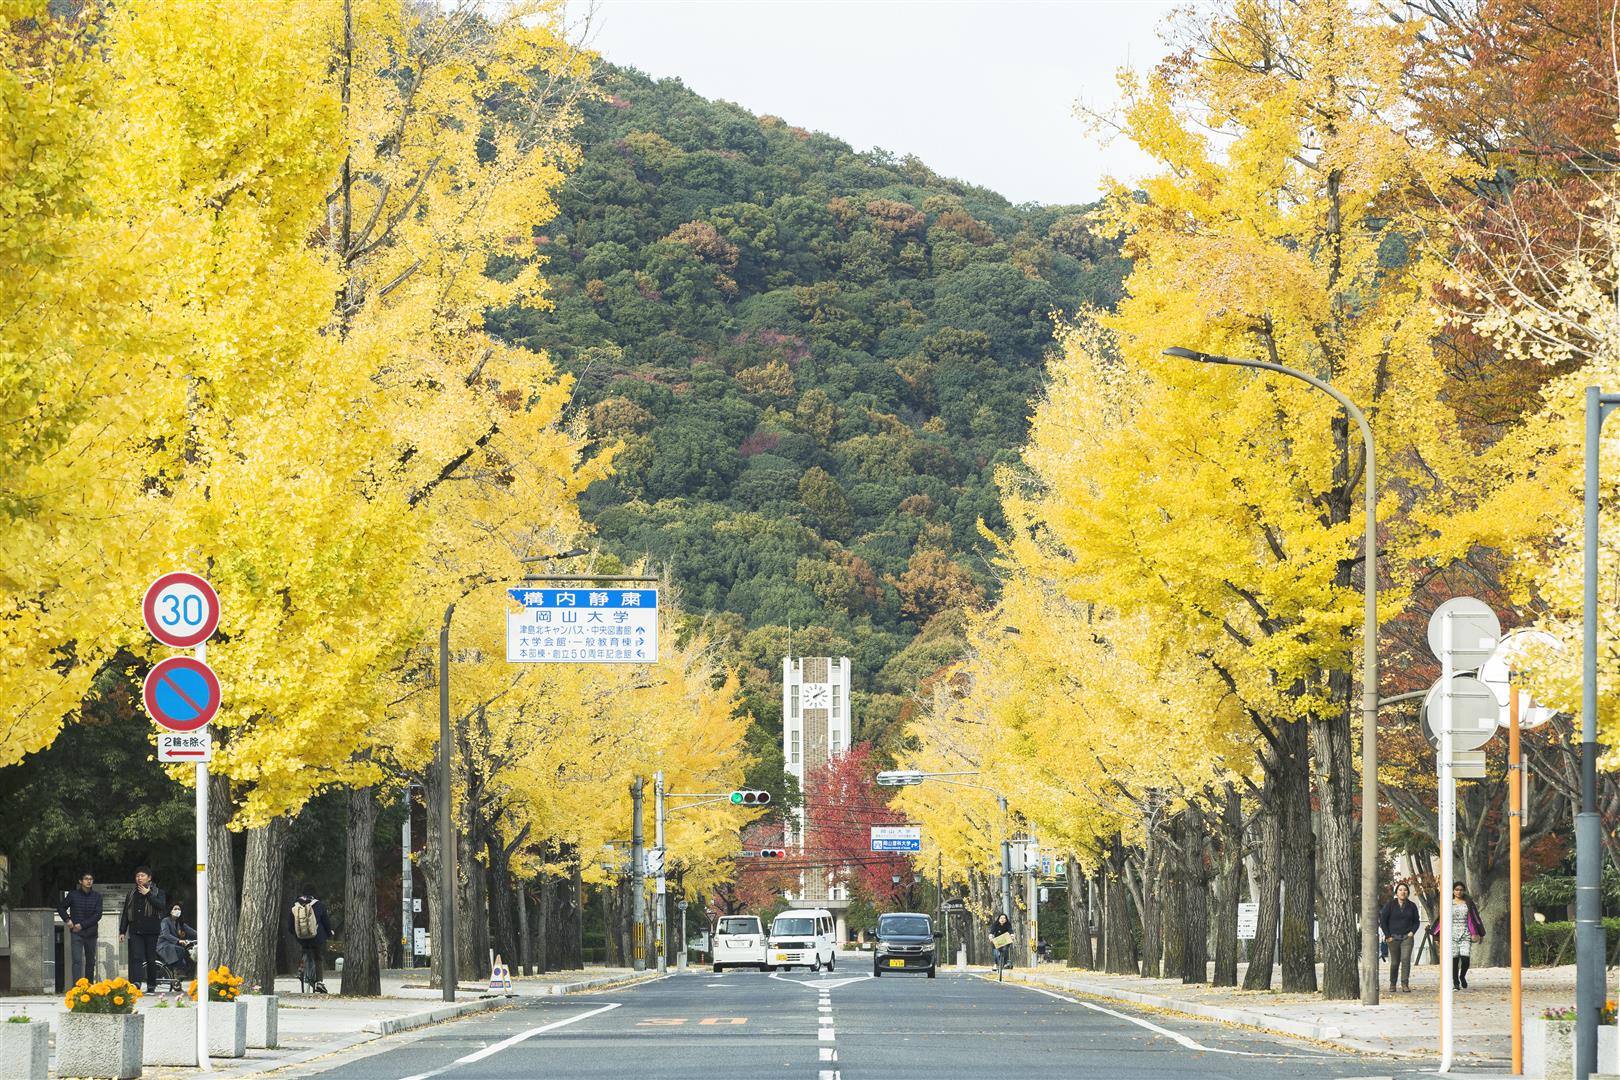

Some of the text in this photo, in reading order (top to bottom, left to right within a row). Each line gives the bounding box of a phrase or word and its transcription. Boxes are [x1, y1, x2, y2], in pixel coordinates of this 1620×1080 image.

[523, 591, 641, 606] 構内静粛
[162, 594, 203, 626] 30
[536, 610, 629, 623] 岡山大学
[164, 736, 206, 747] 2輪を除く
